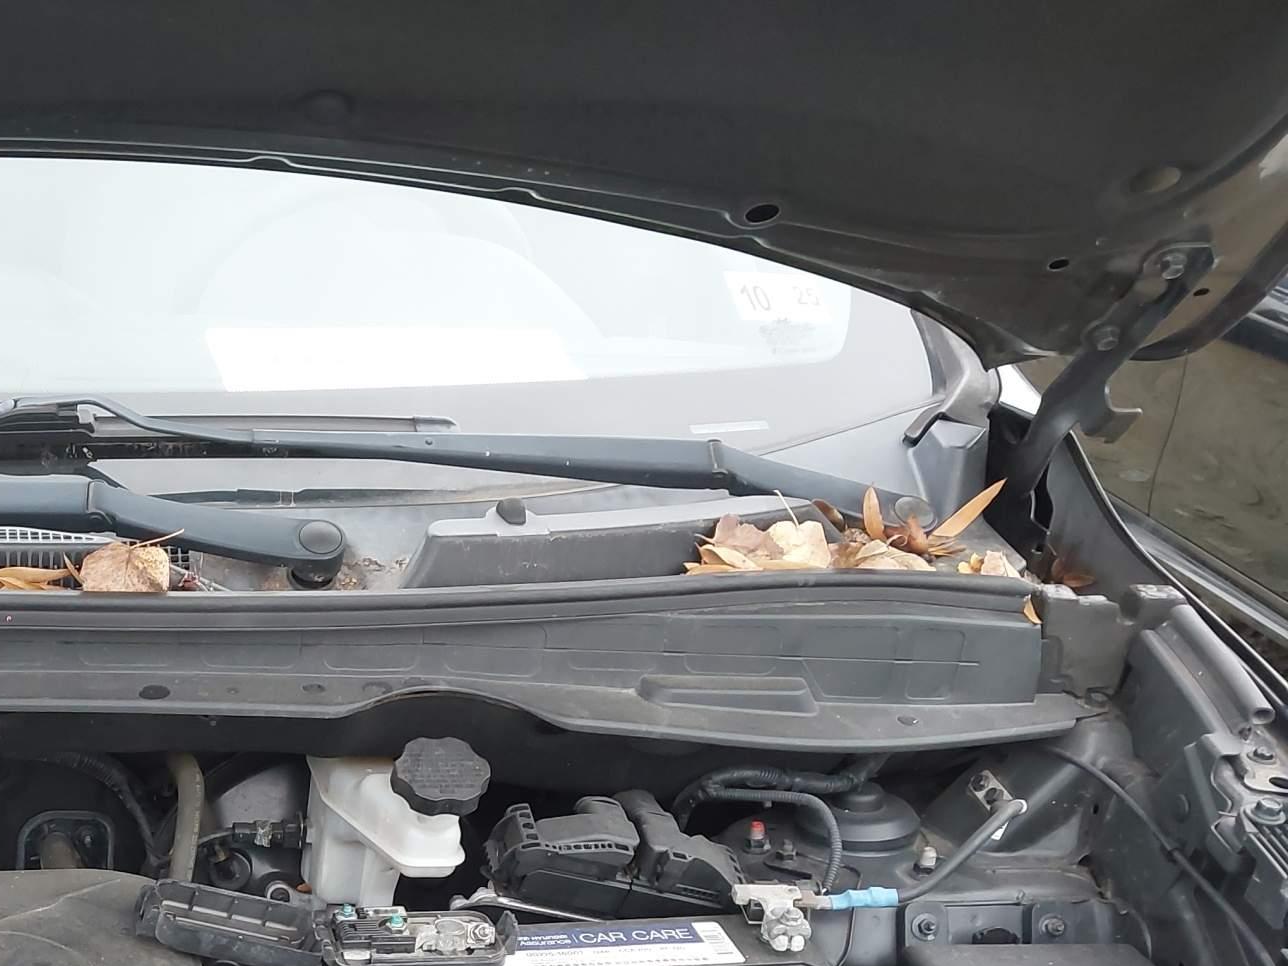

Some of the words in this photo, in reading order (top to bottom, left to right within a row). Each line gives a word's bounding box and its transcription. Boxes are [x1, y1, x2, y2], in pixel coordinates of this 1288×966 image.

[740, 284, 772, 312] 10
[519, 939, 573, 947] Assurance
[579, 931, 627, 945] CAR
[632, 928, 693, 942] CARE
